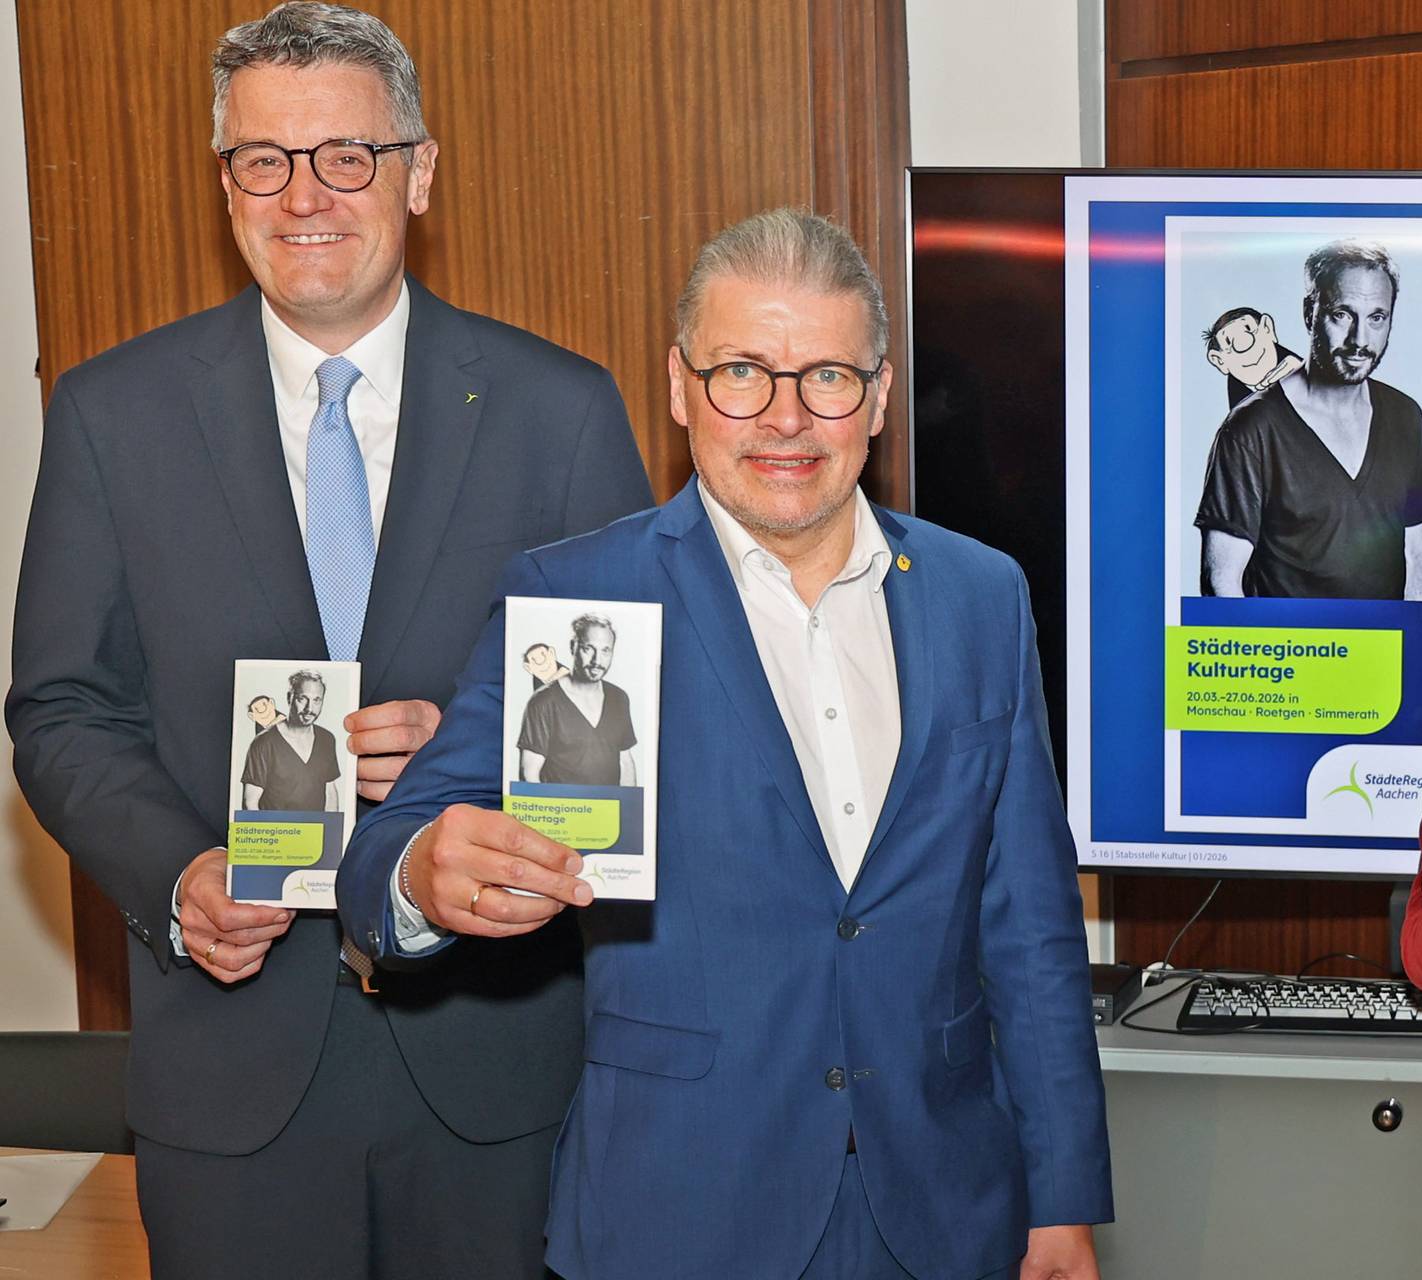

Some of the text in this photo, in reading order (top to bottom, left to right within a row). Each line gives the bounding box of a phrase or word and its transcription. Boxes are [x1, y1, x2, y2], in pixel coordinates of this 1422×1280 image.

[1187, 637, 1348, 661] Städteregionale
[1187, 661, 1295, 683] Kulturtage
[1288, 692, 1299, 704] in
[1186, 705, 1379, 720] Monschau Roetgen Simmerath
[1375, 788, 1418, 799] Aachen
[512, 801, 592, 813] Städteregionale
[235, 827, 301, 836] Städteregionale
[235, 836, 279, 845] Kulturtage
[1115, 850, 1160, 860] Stabsstelle
[1161, 852, 1187, 860] Kultur
[1193, 853, 1228, 862] 01/2026
